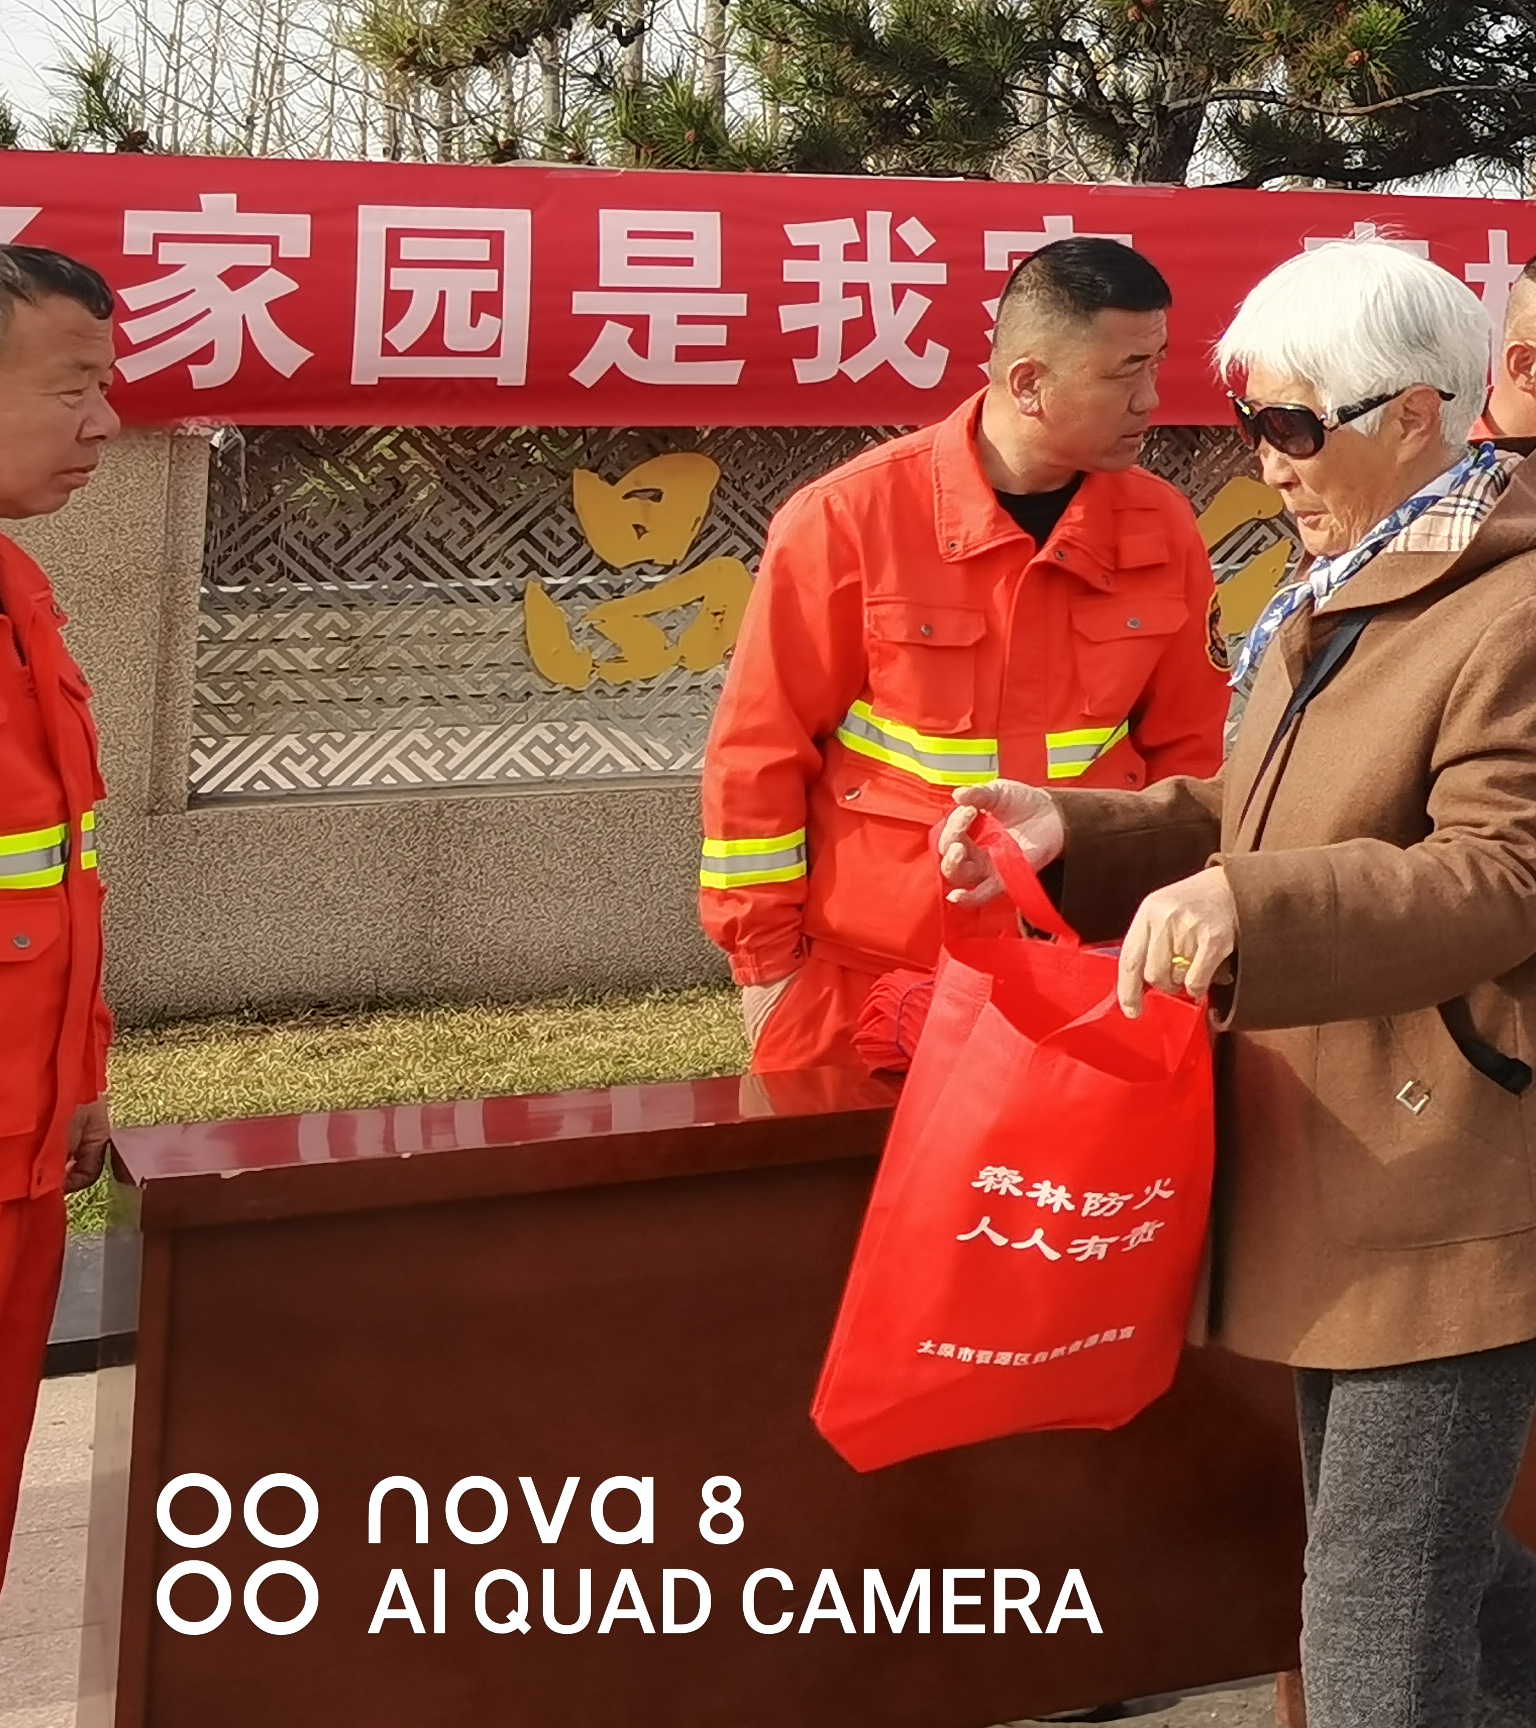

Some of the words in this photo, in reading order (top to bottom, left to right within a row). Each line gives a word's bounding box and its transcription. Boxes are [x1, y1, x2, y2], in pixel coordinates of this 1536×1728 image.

[0, 192, 1134, 390] 家园是我
[971, 1165, 1175, 1217] 森林防火
[956, 1216, 1165, 1262] 人人有责
